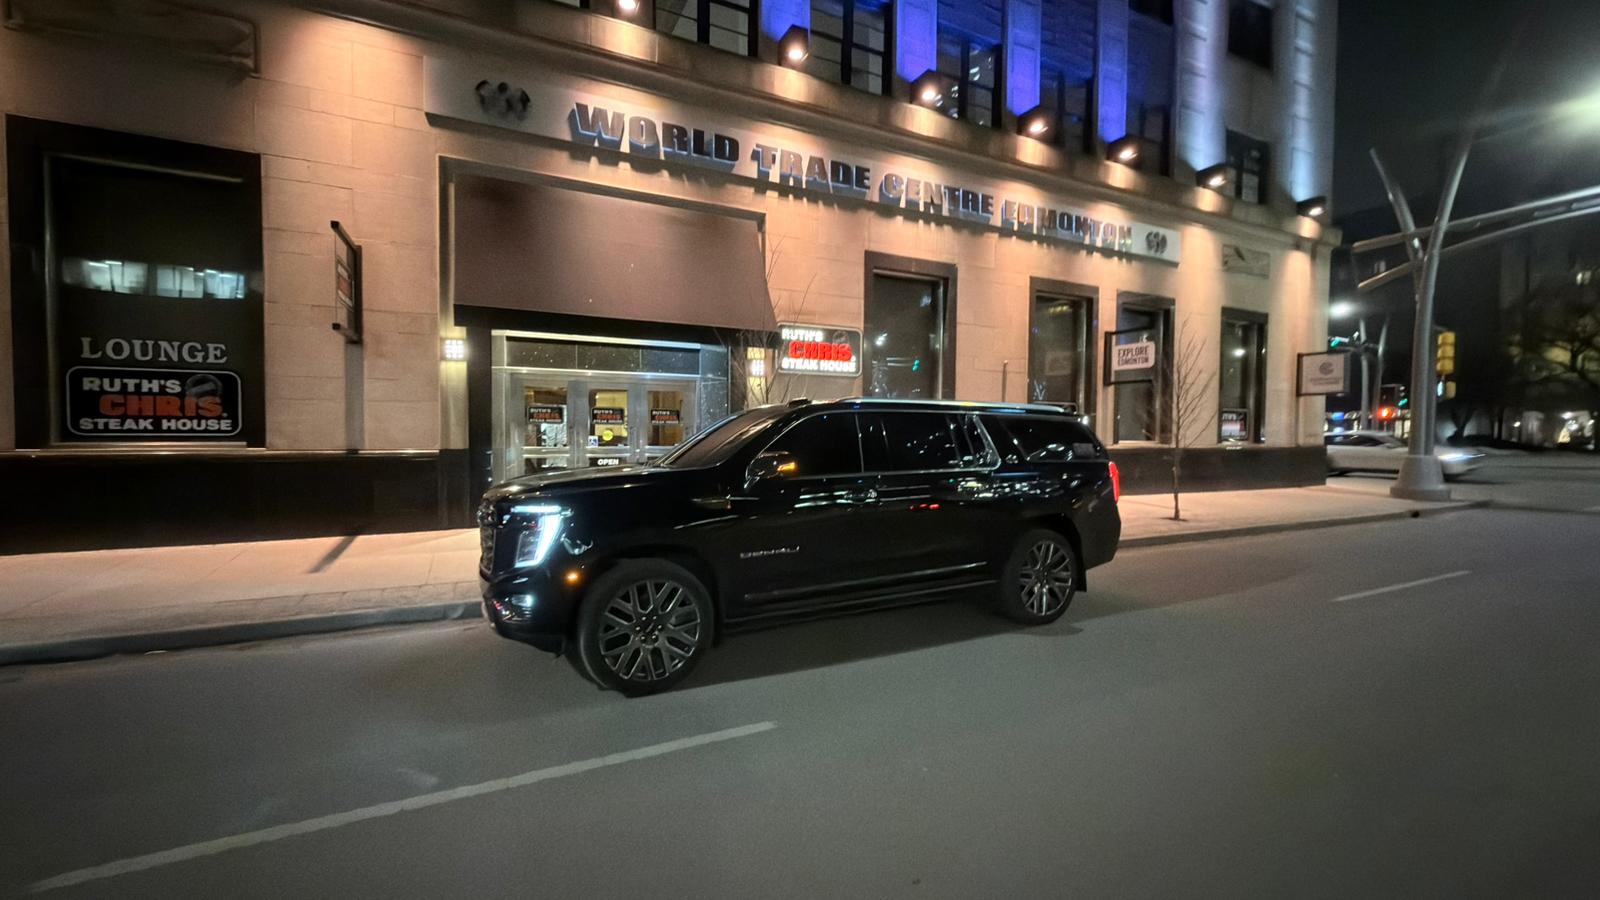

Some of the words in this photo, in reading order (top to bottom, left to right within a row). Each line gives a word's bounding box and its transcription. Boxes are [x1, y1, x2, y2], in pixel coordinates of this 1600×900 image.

[570, 102, 740, 168] WORLD
[752, 143, 871, 194] TRADE
[880, 172, 995, 219] CENTRE
[1001, 199, 1132, 246] EDMONTON
[781, 328, 823, 342] RUTH'S
[80, 337, 228, 363] LOUNGE
[789, 340, 852, 362] CHRIS
[1118, 345, 1149, 358] EXPLORE
[781, 357, 818, 370] STEAK
[819, 359, 857, 372] HOUSE
[82, 377, 182, 393] RUTH'S
[100, 394, 223, 417] CHRIS
[79, 418, 154, 430] STEAK
[162, 419, 232, 430] HOUSE
[597, 458, 619, 466] OPEN
